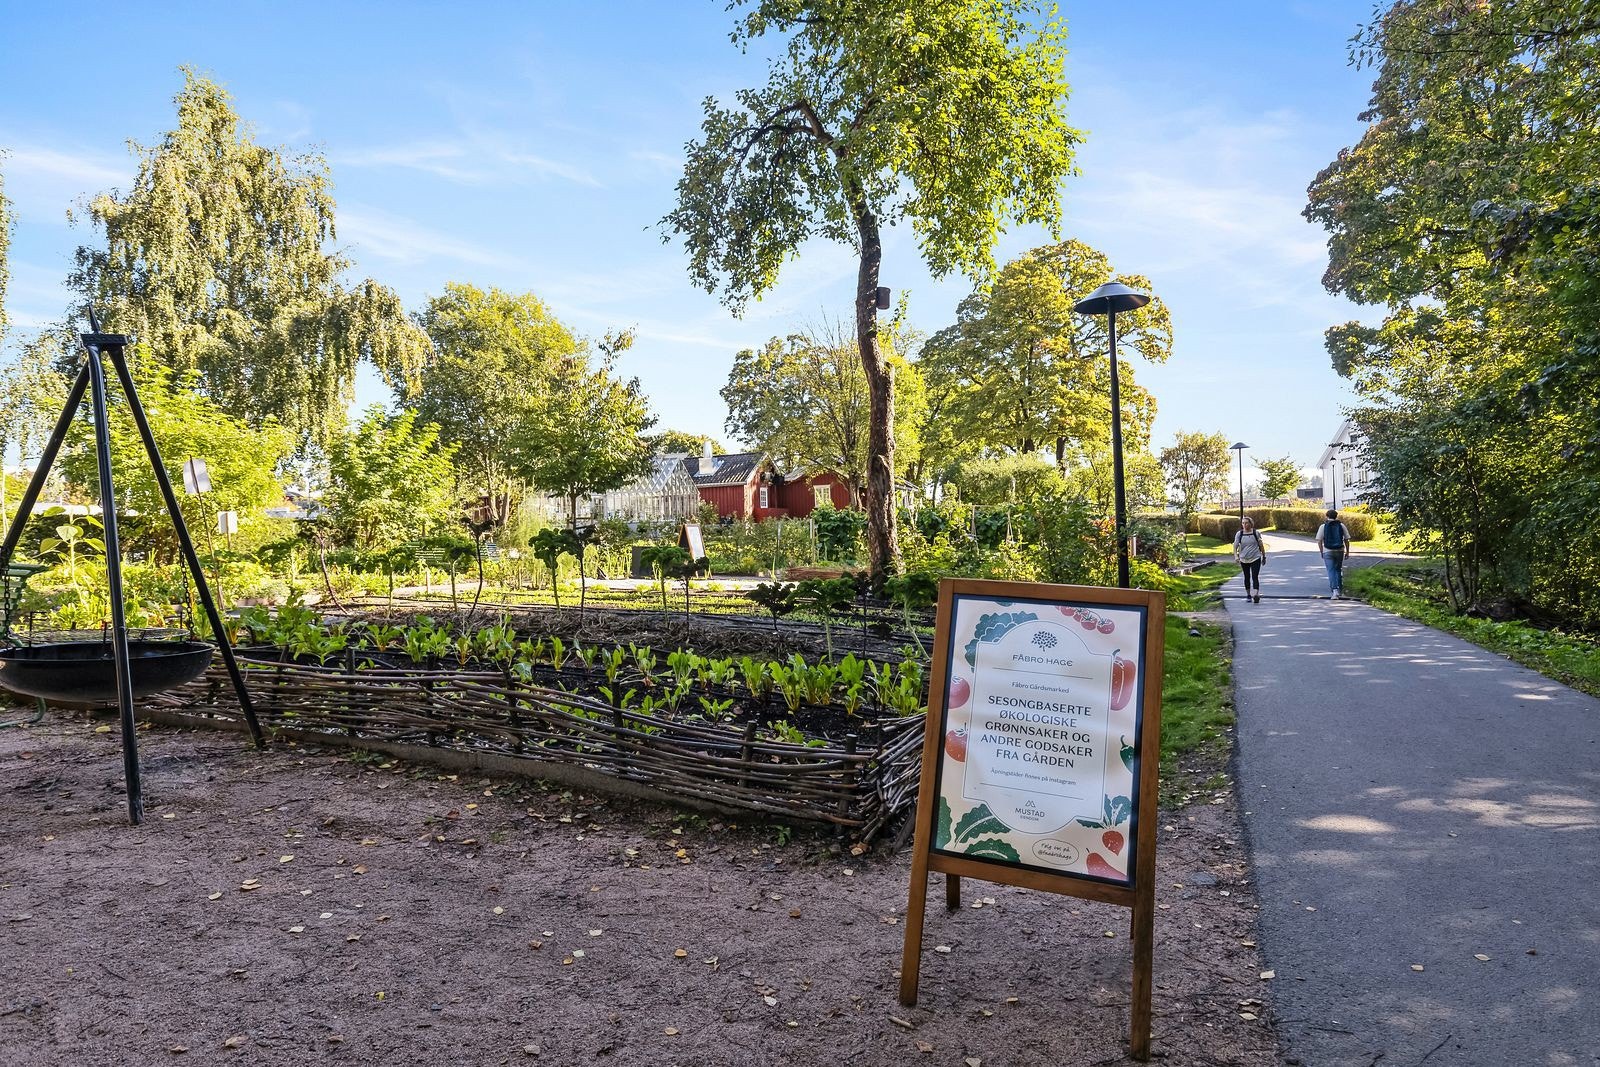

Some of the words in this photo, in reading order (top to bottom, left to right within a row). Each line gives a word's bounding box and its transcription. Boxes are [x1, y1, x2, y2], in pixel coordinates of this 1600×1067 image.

[1012, 654, 1044, 664] FÅBRO
[1011, 681, 1029, 689] Fåbro
[1030, 683, 1070, 694] Gårdsmarked
[988, 695, 1092, 716] SESONGBASERTE
[999, 710, 1077, 728] ØKOLOGISKE
[985, 721, 1068, 740] GRØNNSAKER
[1072, 732, 1090, 743] OG
[980, 734, 1021, 748] ANDRE
[1025, 739, 1093, 757] GODSAKER
[996, 749, 1019, 761] FRA
[1022, 751, 1074, 768] GÅRDEN
[1041, 774, 1049, 782] på
[1015, 807, 1046, 818] MUSTAD
